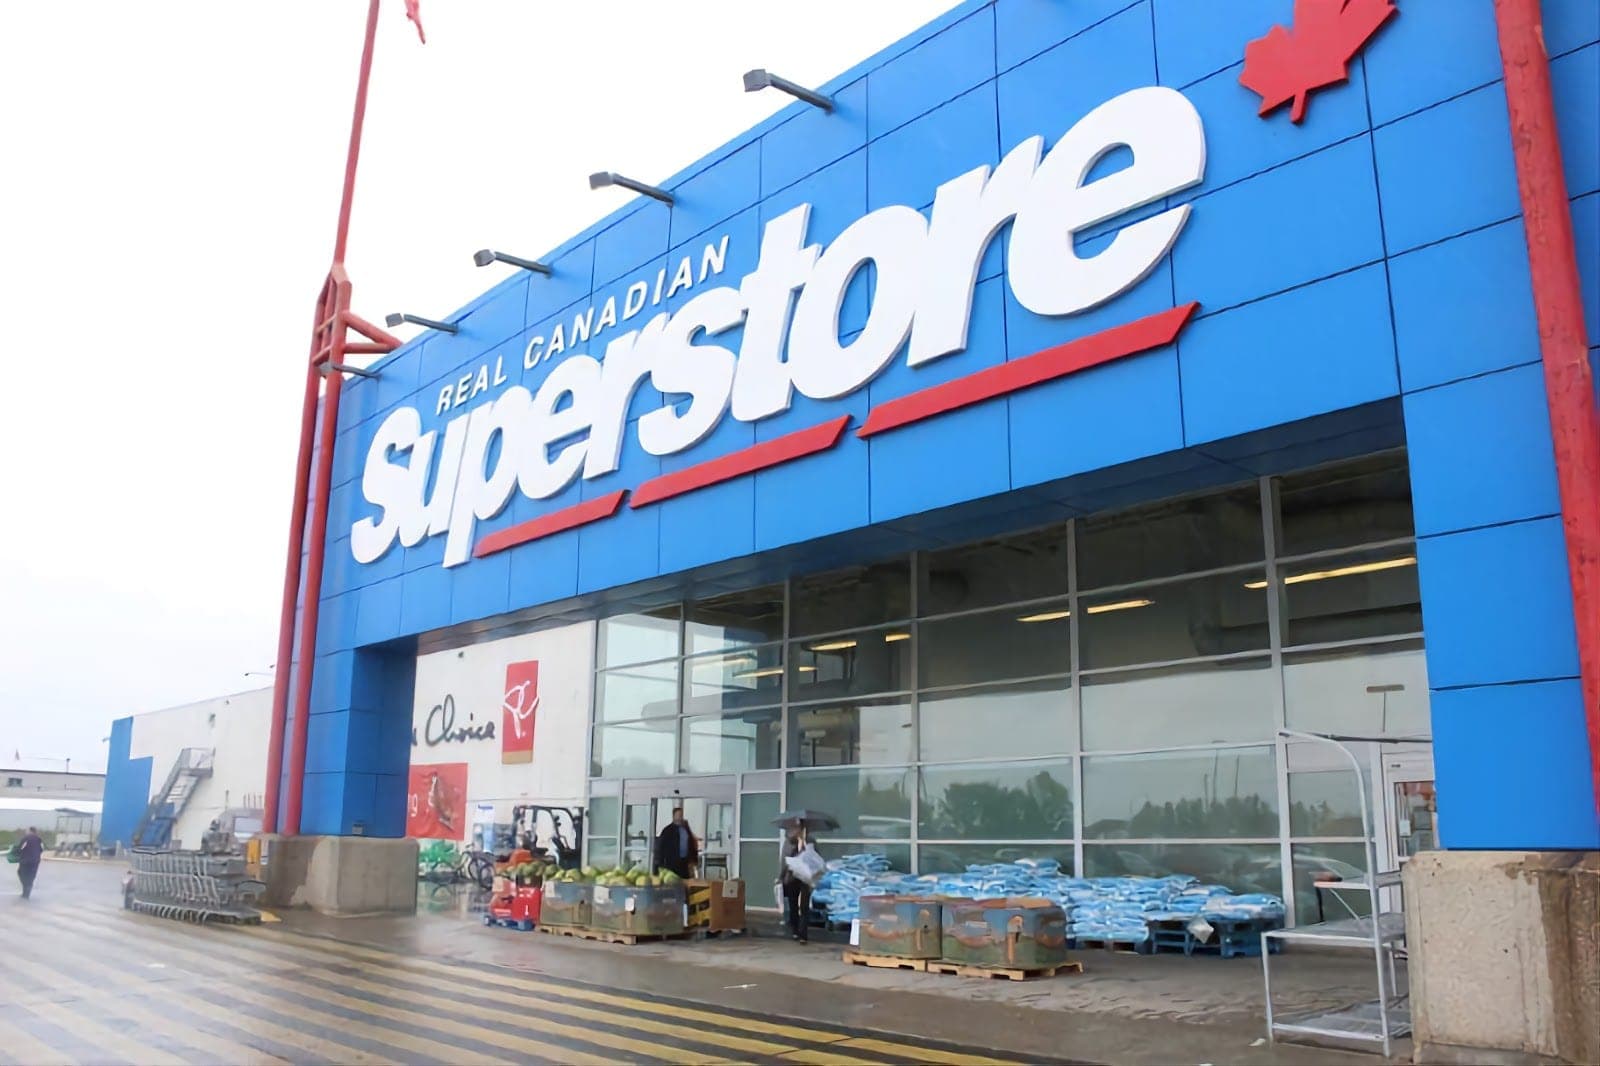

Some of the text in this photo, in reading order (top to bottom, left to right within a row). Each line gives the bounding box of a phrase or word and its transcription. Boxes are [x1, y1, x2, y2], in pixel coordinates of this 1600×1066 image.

[351, 86, 1206, 568] Superstore
[436, 235, 730, 415] REAL CANADIAN
[425, 693, 496, 747] Choice
